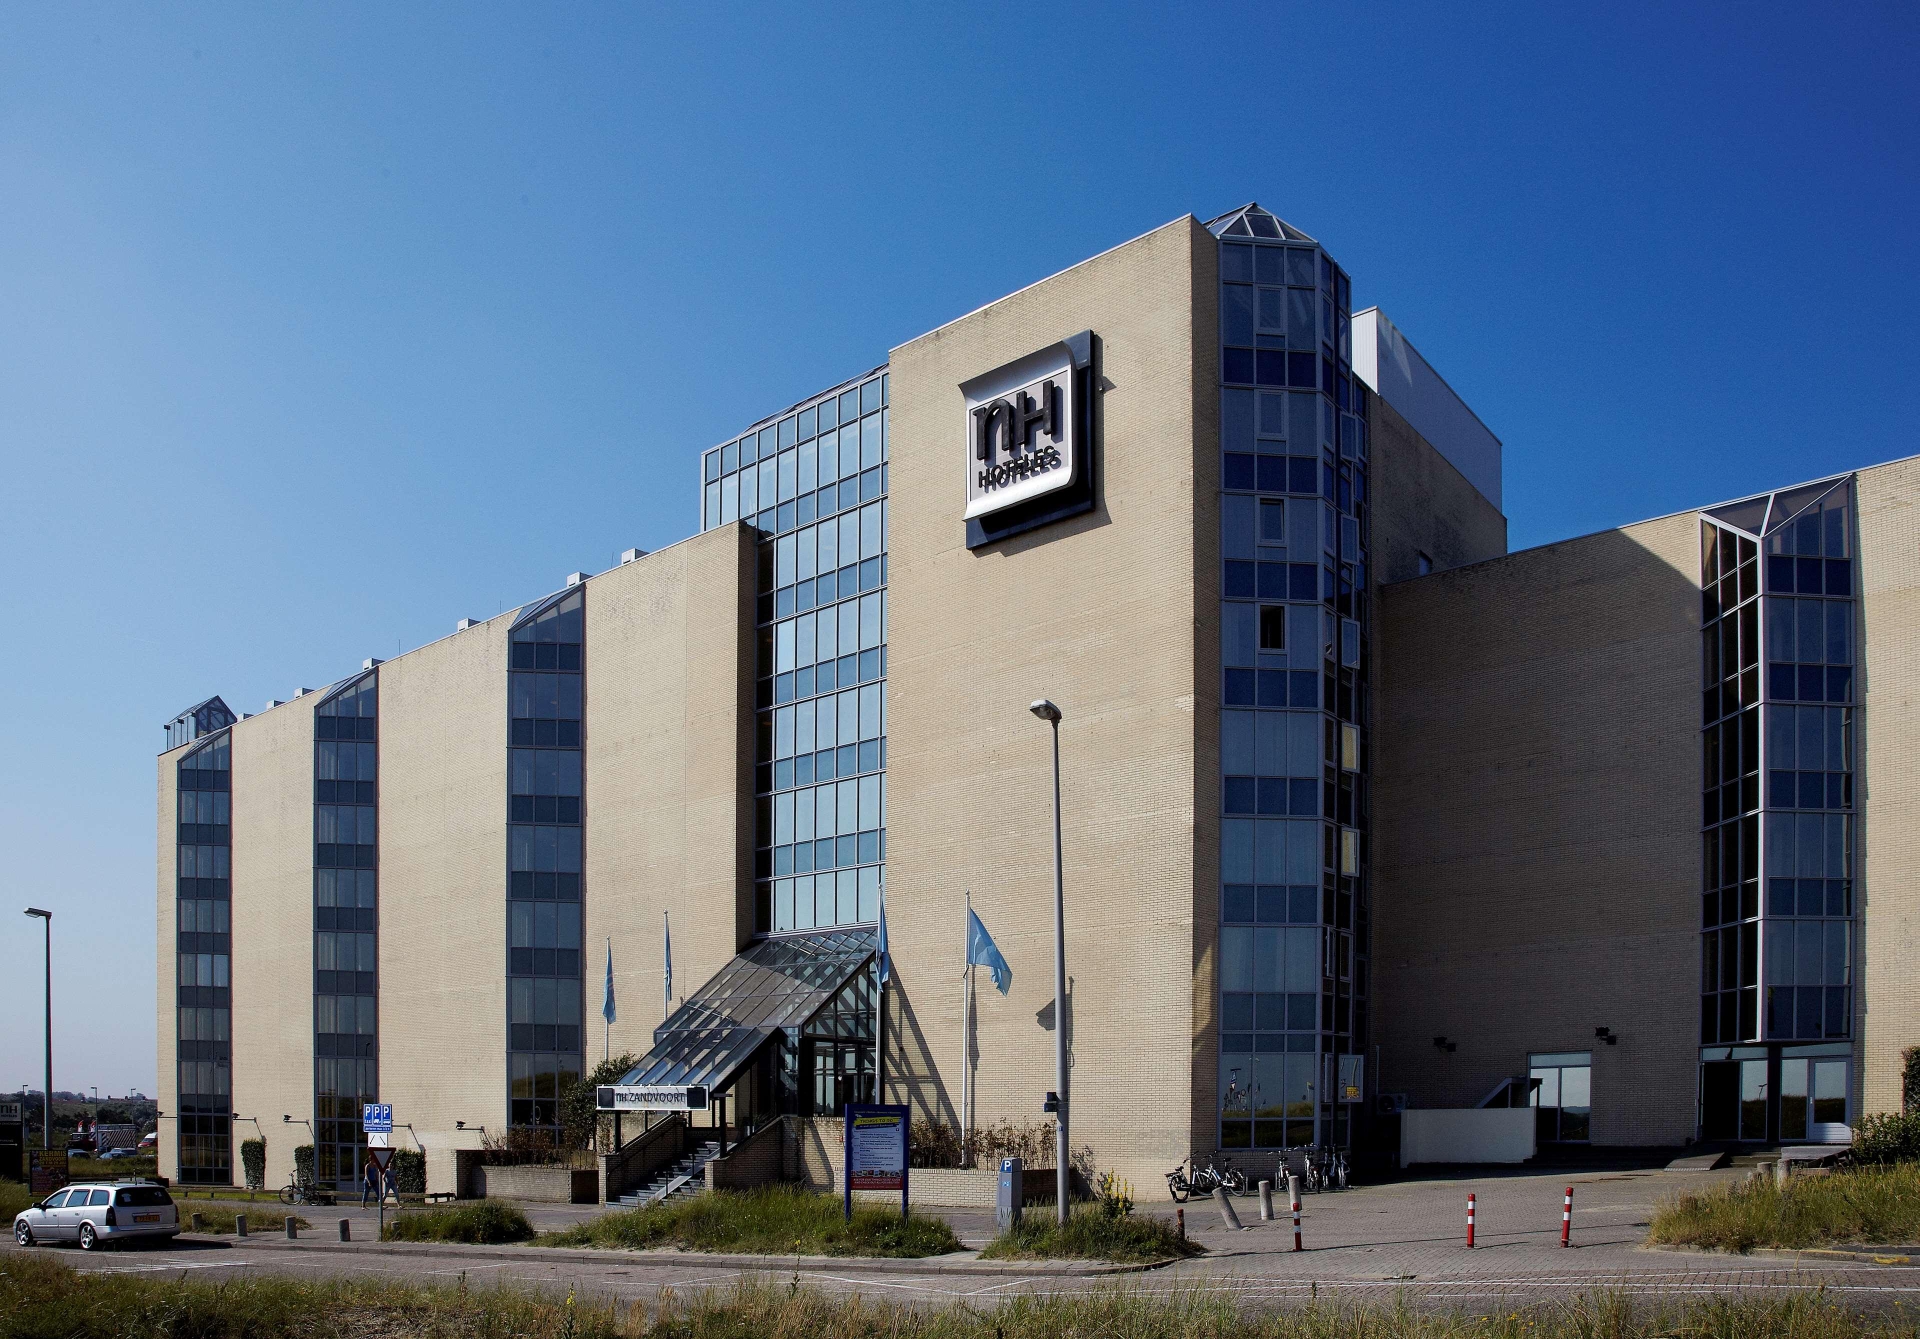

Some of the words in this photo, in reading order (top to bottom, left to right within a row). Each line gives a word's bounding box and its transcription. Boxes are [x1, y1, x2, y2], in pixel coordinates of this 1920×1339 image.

[978, 445, 1056, 489] HOTELES
[628, 1092, 686, 1103] ZANDVOORT
[1004, 1160, 1011, 1171] P
